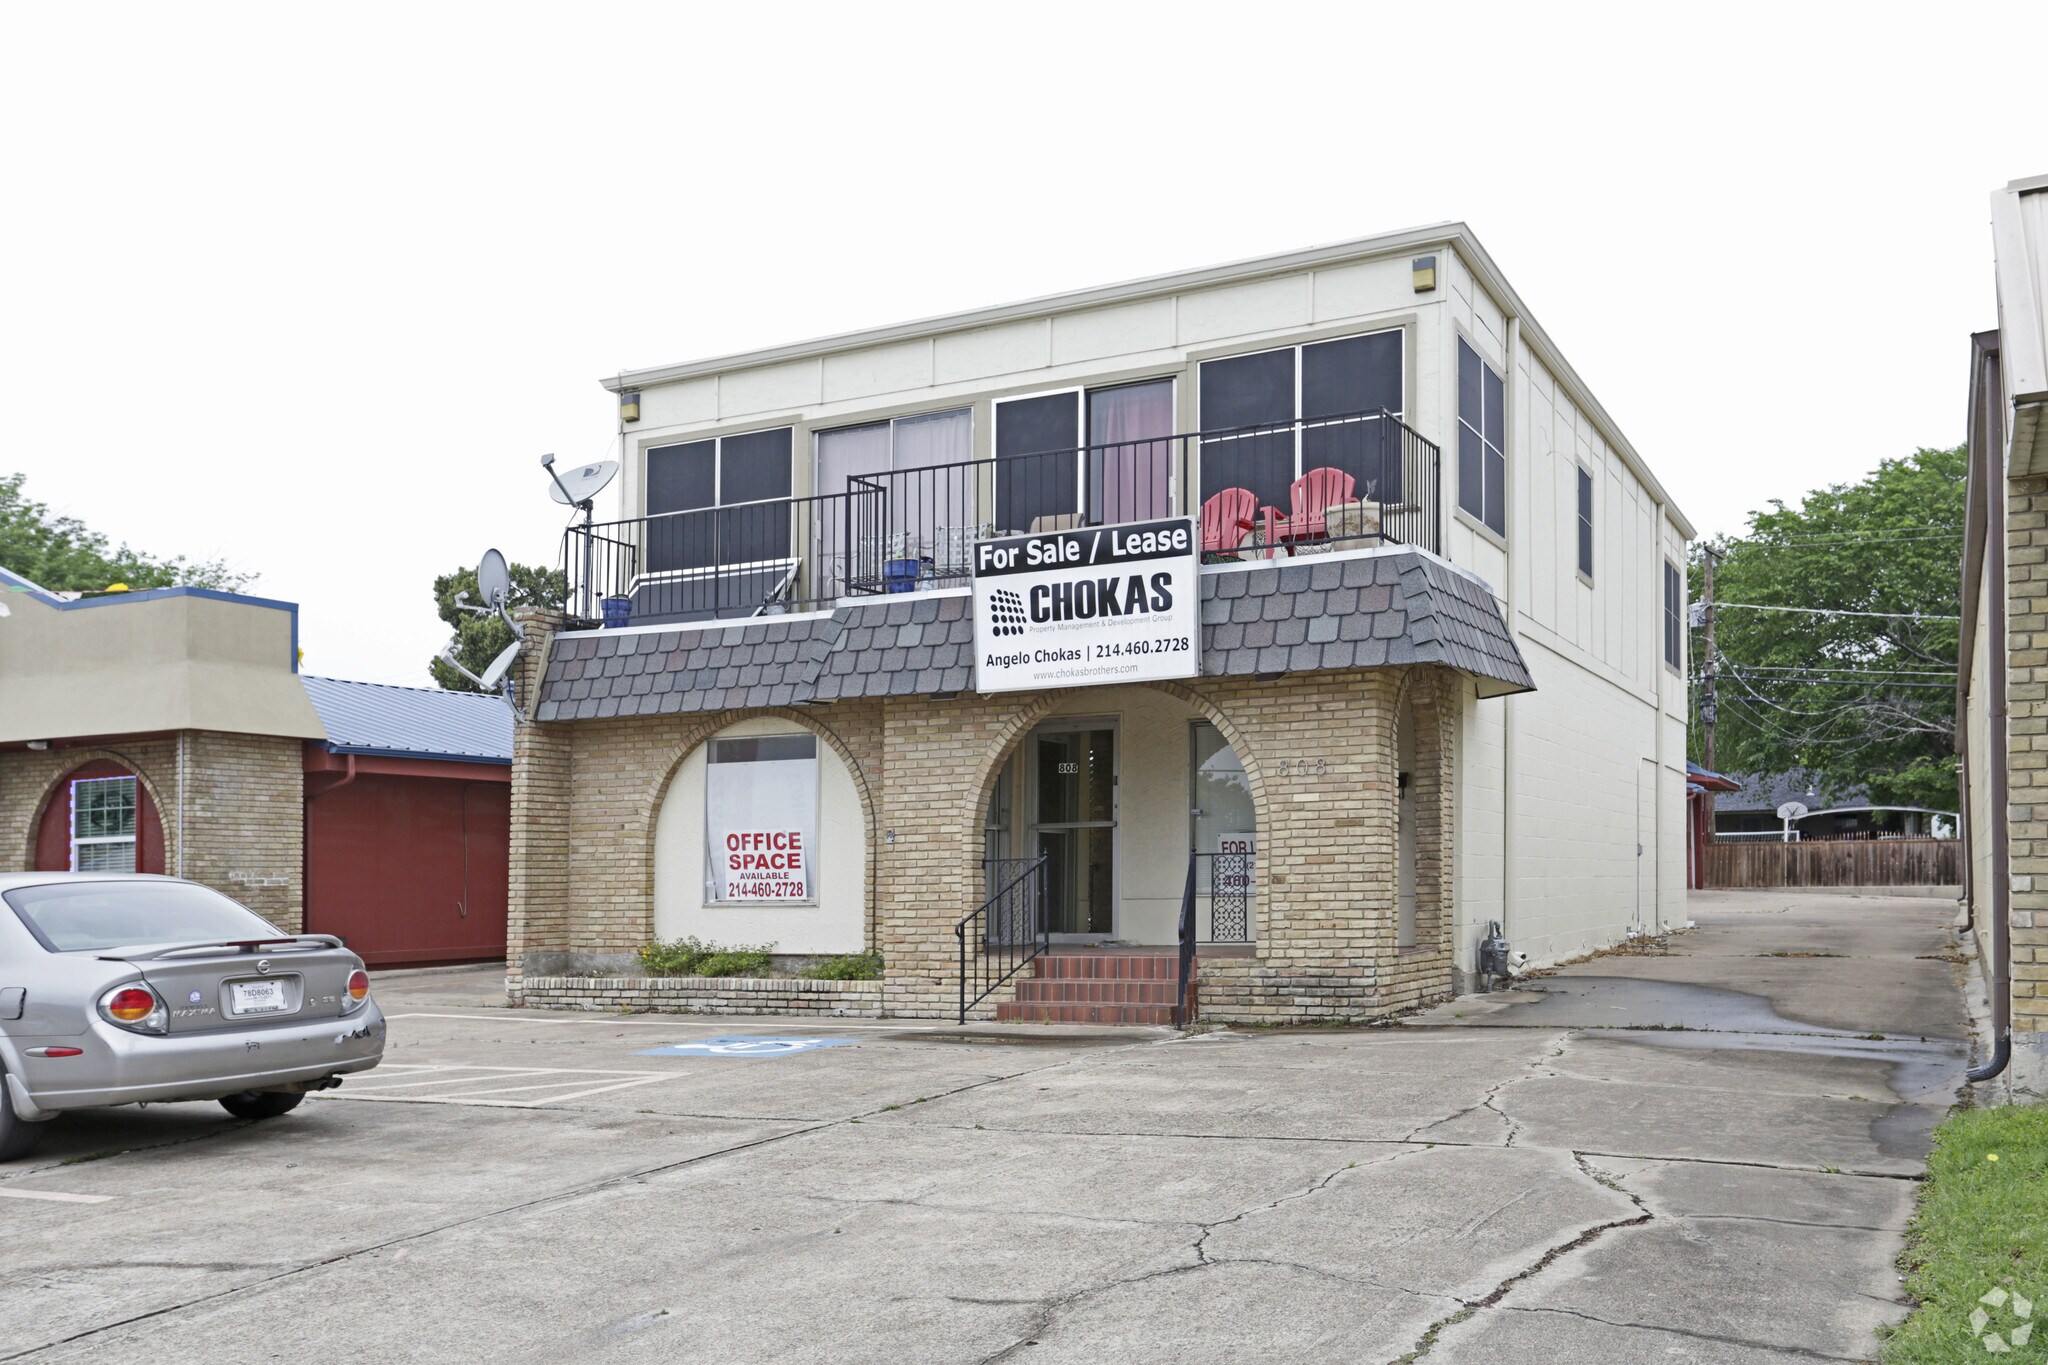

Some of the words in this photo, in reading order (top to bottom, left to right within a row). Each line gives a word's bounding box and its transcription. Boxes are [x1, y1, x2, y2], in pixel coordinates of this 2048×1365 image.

[979, 544, 1019, 571] For
[1026, 535, 1080, 566] Sale
[1089, 531, 1102, 564] /
[1111, 527, 1188, 557] Lease
[1029, 572, 1173, 623] CHOKAS
[1029, 624, 1056, 634] Property
[1057, 620, 1100, 632] Management
[1107, 615, 1151, 627] Development
[1152, 614, 1173, 623] Group
[986, 648, 1030, 669] Angelo
[1034, 647, 1081, 663] Chokas
[1096, 637, 1189, 659] 214.460.2728
[1033, 664, 1138, 681] www.chokasbrothers.com
[1059, 764, 1077, 773] 808
[1279, 758, 1326, 777] 808
[726, 832, 802, 851] OFFICE
[1221, 841, 1248, 855] FOR
[729, 853, 802, 870] SPACE
[740, 872, 790, 880] AVAILABLE
[728, 881, 804, 897] 214-460-2728
